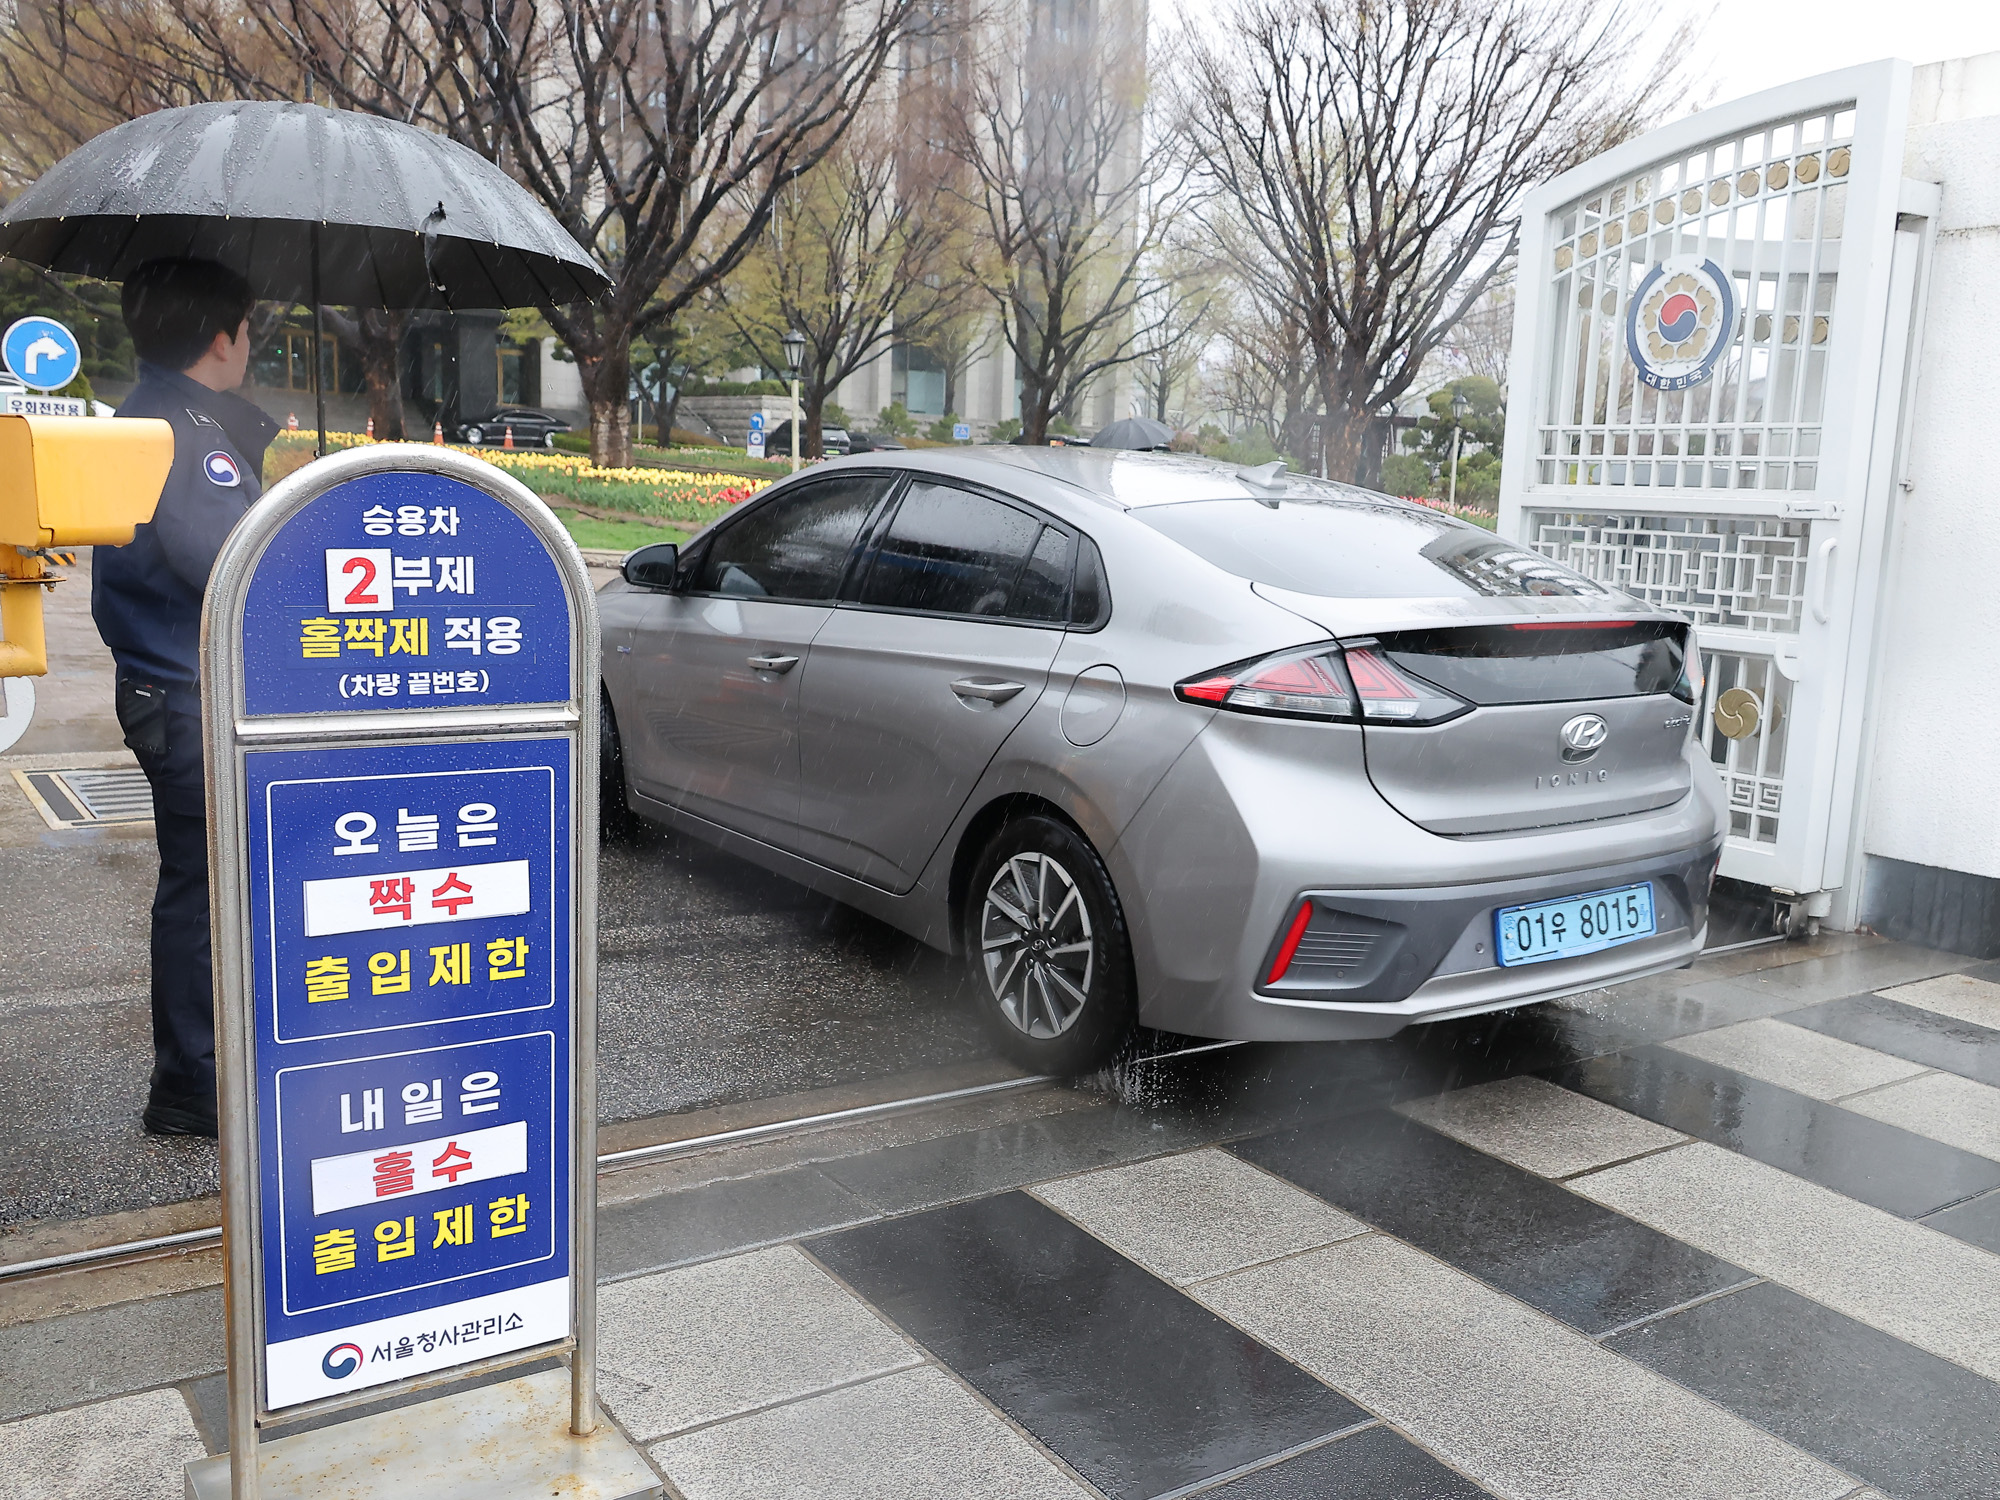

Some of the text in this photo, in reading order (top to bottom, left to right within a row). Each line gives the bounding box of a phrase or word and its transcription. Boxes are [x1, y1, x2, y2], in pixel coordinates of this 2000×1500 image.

[1645, 370, 1703, 390] 대한민국
[362, 504, 461, 536] 승용차
[299, 616, 523, 658] 홀짝제 적용
[338, 669, 490, 698] (차량 끝번호)
[1517, 912, 1567, 951] 01우
[1580, 894, 1639, 939] 8015
[370, 1312, 524, 1364] 서울청사관리소
